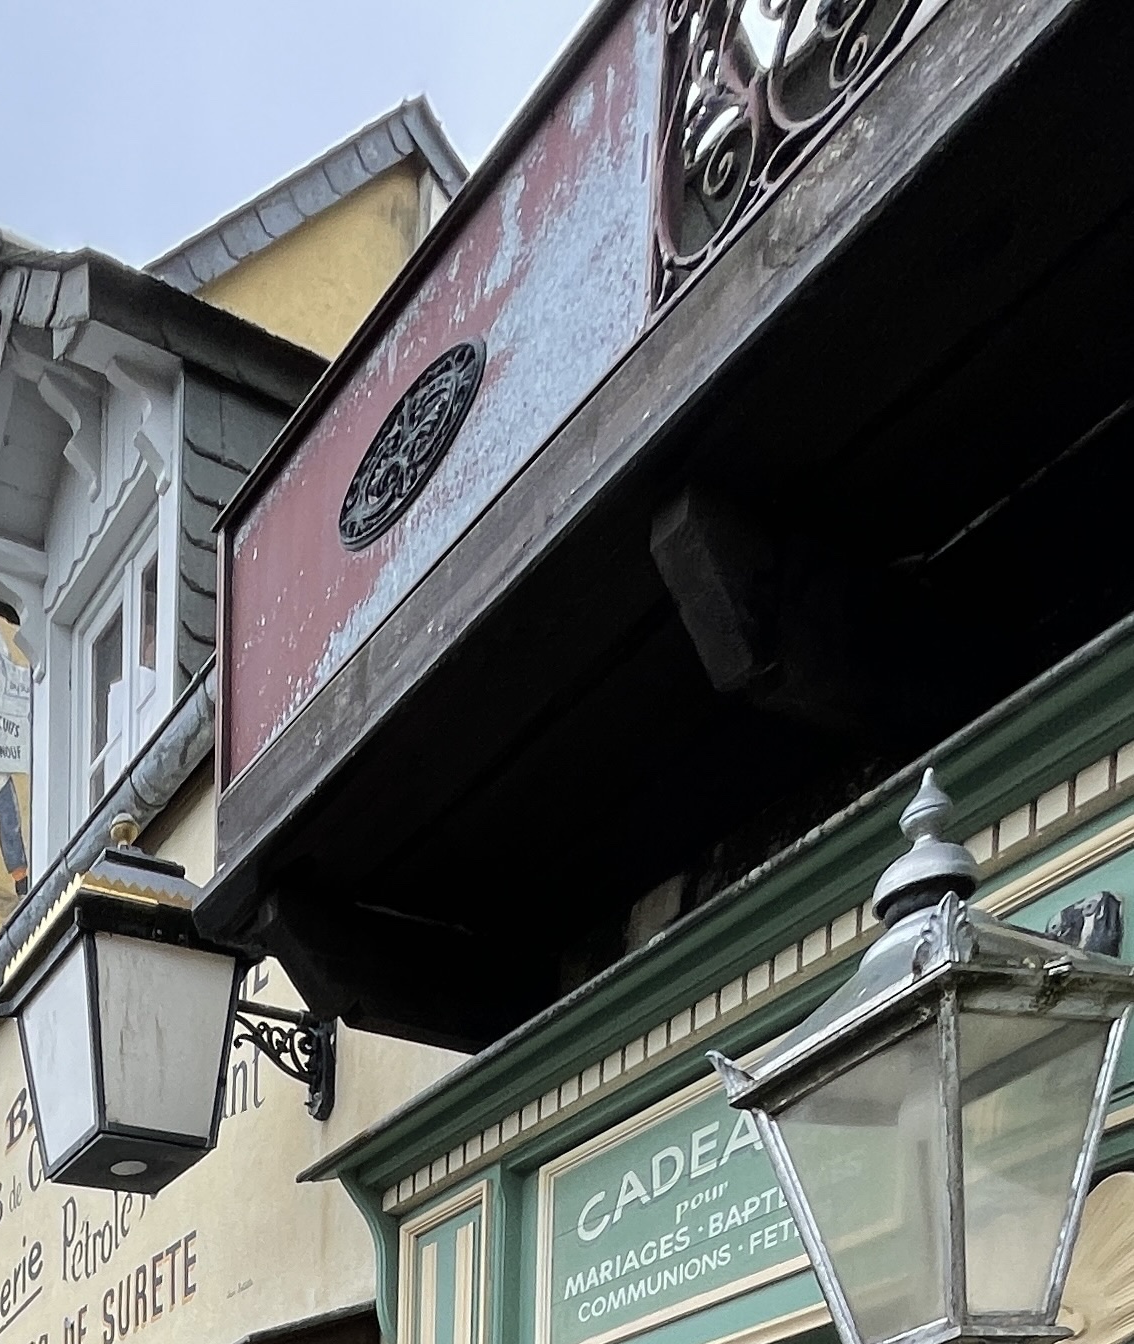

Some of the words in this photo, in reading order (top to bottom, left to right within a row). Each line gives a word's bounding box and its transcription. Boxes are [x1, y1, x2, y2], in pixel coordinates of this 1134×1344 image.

[8, 1175, 23, 1213] de
[674, 1180, 729, 1225] pour
[564, 1226, 691, 1300] MARIAGES
[578, 1243, 732, 1323] COMMUNIONS
[750, 1217, 800, 1255] FET
